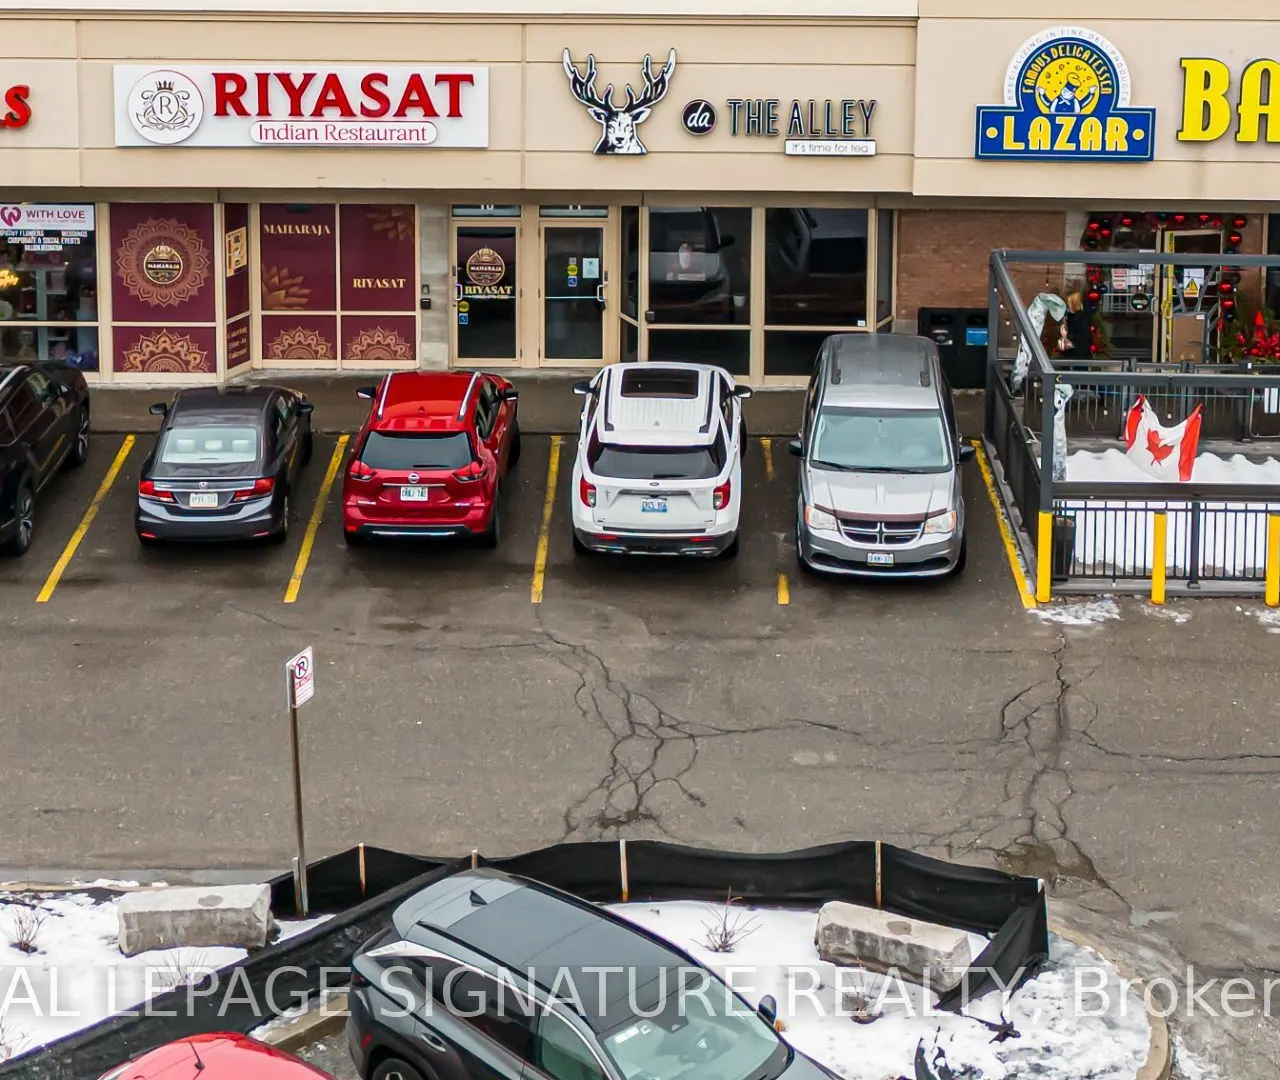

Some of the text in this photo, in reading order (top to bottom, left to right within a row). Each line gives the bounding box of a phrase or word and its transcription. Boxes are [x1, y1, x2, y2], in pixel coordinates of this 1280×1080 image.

[1023, 52, 1051, 94] FAMOUS
[212, 72, 474, 118] RIYASAT
[726, 99, 877, 137] THE ALLEY
[258, 124, 428, 142] Indian Restaurant
[1002, 115, 1129, 152] LAZAR
[809, 143, 831, 153] time
[834, 143, 848, 153] for
[851, 143, 869, 153] tea
[26, 210, 85, 219] WITH LOVE
[263, 224, 331, 236] MAHARAJA
[353, 278, 406, 288] RIYASAT
[464, 286, 512, 295] RIYASAT
